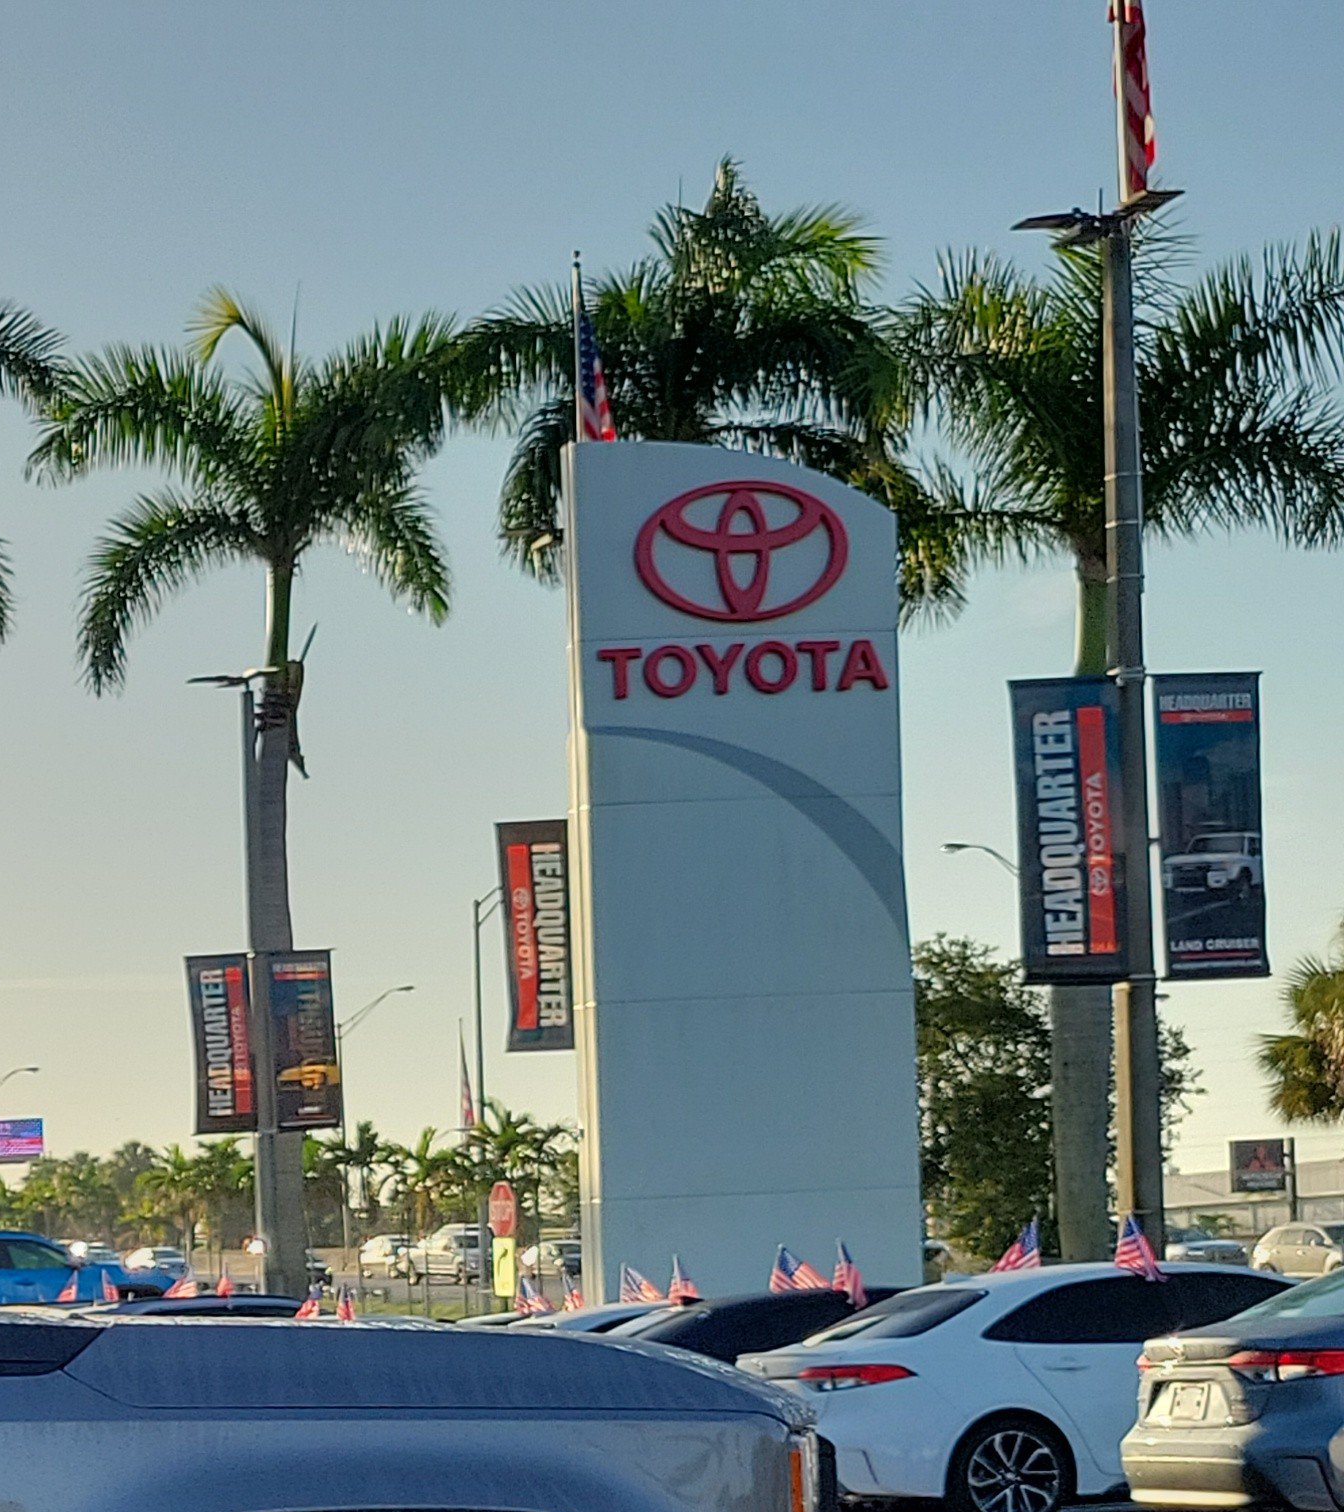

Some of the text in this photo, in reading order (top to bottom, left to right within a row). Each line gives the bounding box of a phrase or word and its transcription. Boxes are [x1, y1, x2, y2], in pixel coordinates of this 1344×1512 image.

[597, 639, 889, 700] TOYOTA
[1032, 709, 1086, 956] HEADQUARTER
[1085, 772, 1109, 865] TOYOTA
[516, 911, 535, 980] TOYOTA
[530, 842, 568, 1027] HEADQUARTER
[1170, 937, 1260, 952] LAND CRUISER
[199, 968, 235, 1117] HEADQUARTER
